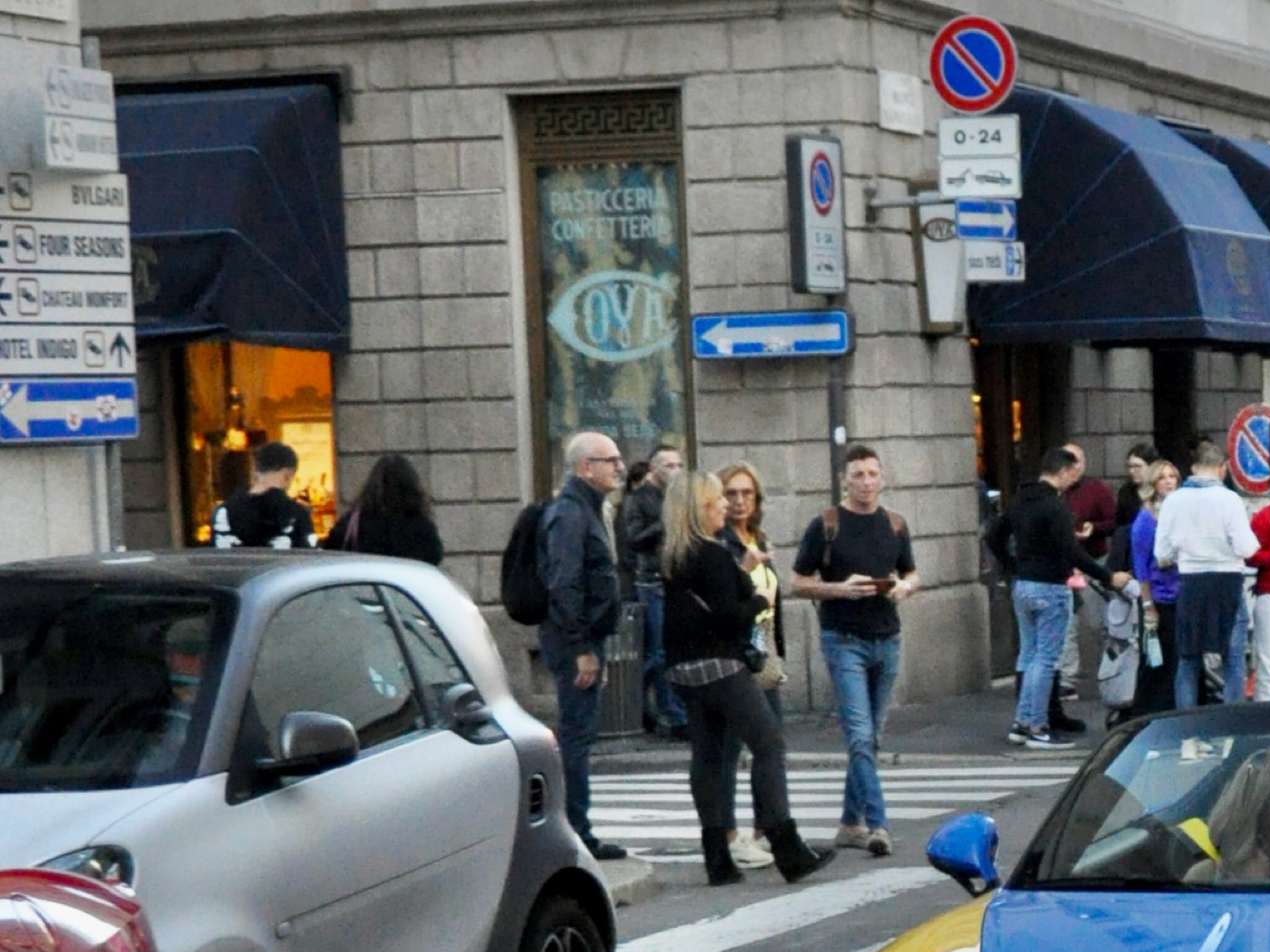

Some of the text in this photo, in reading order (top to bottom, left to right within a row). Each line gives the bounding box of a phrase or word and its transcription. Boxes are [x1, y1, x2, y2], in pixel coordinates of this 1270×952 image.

[71, 185, 125, 206] BVLGARI
[550, 187, 671, 213] PASTICCERIA
[552, 214, 673, 240] CONFETTERIA
[39, 234, 124, 258] FOUR SEASONS
[36, 338, 77, 359] INDIGO
